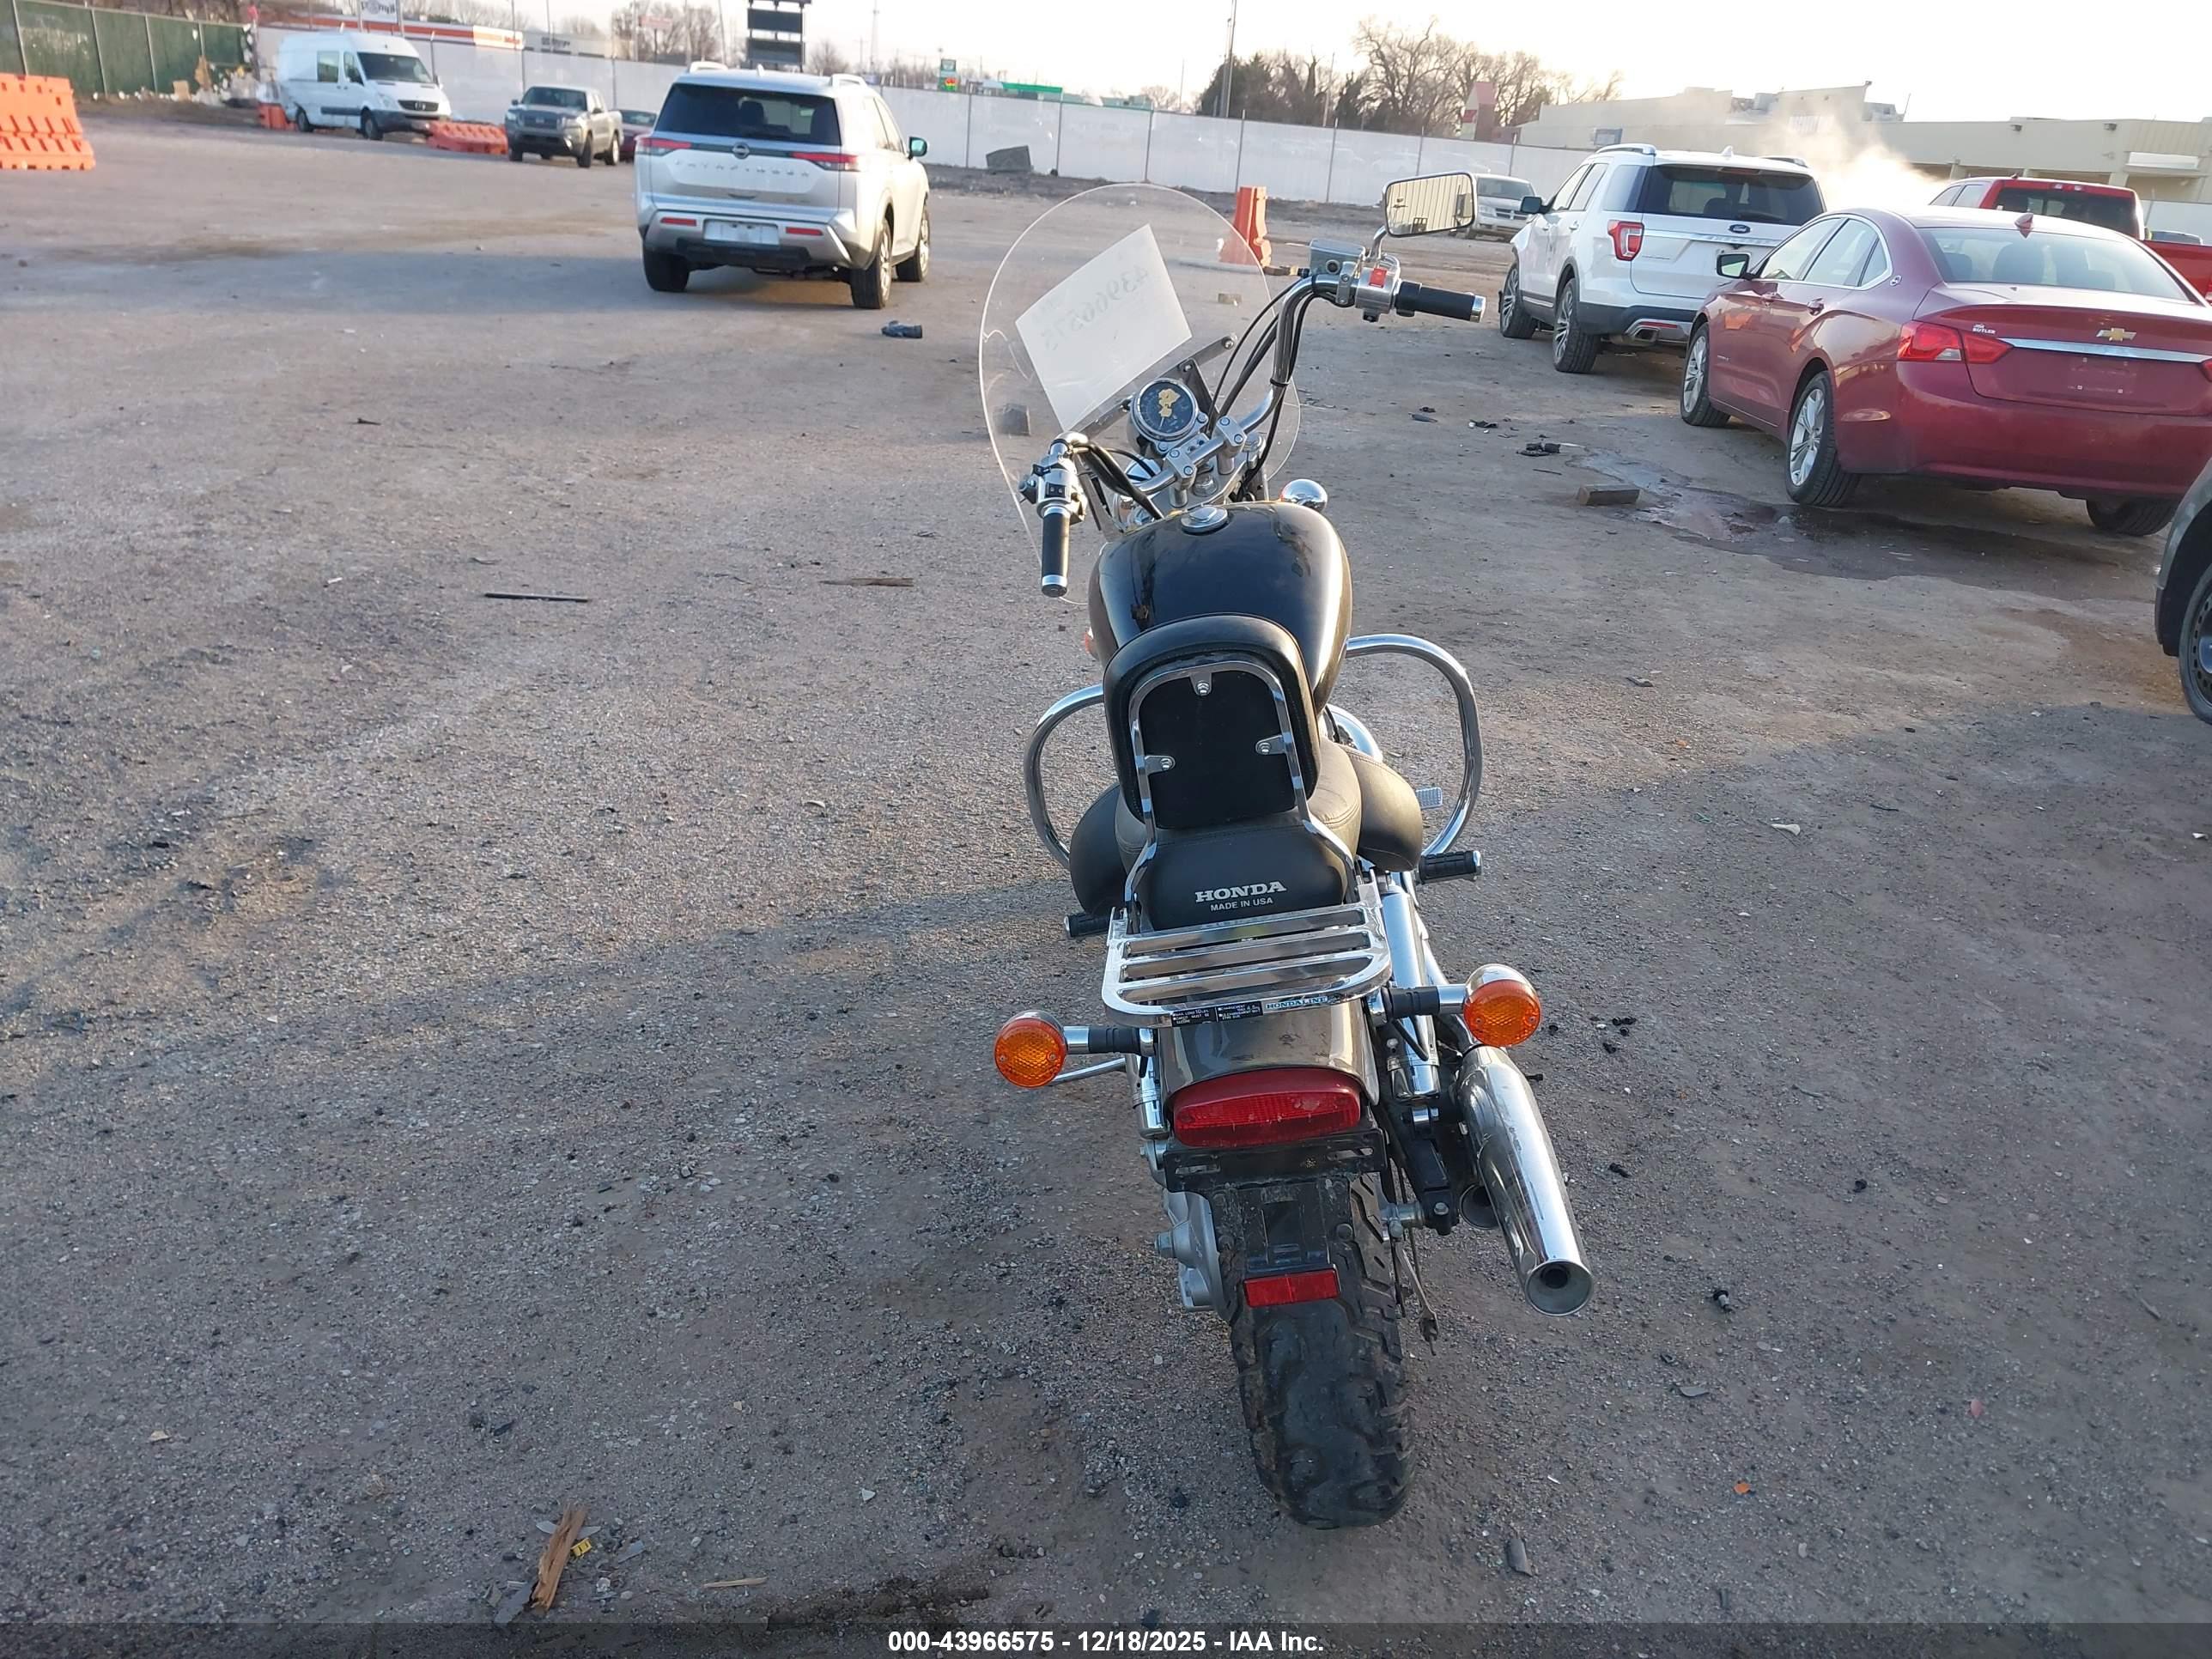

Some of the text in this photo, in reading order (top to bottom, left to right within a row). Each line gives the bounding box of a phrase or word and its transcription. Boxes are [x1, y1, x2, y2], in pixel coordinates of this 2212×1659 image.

[1195, 881, 1286, 902] HONDA
[1211, 901, 1238, 912] MADE
[1253, 897, 1273, 906] USA
[1267, 996, 1328, 1009] HONDALINE
